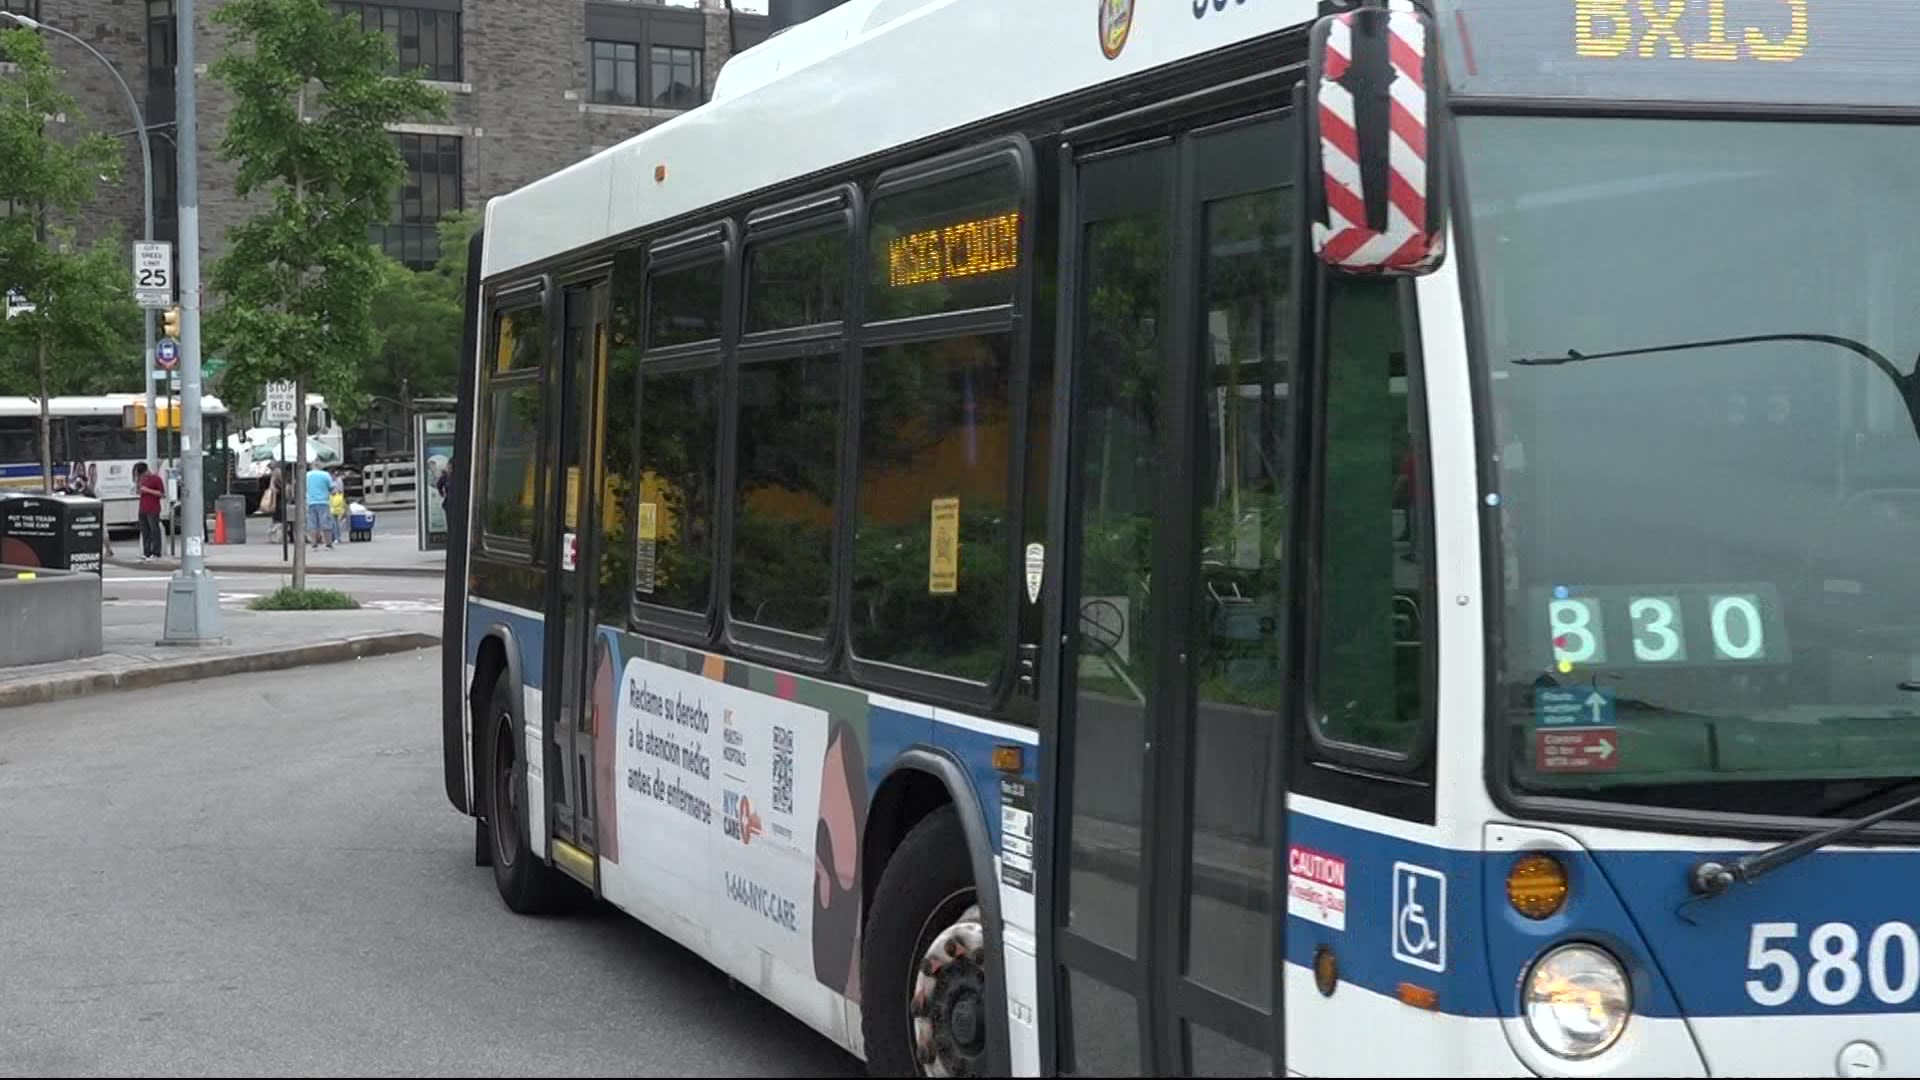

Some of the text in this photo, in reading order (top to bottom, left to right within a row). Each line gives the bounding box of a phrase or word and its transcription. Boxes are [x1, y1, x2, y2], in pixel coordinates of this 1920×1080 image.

[138, 268, 167, 287] 25
[268, 382, 294, 393] STOP
[271, 401, 292, 412] RED
[629, 677, 710, 734] Reclame su derecho
[628, 718, 711, 781] a la atención médica
[627, 766, 712, 825] antes de enfermarse
[723, 788, 740, 819] NYC
[1289, 848, 1345, 889] CAUTION
